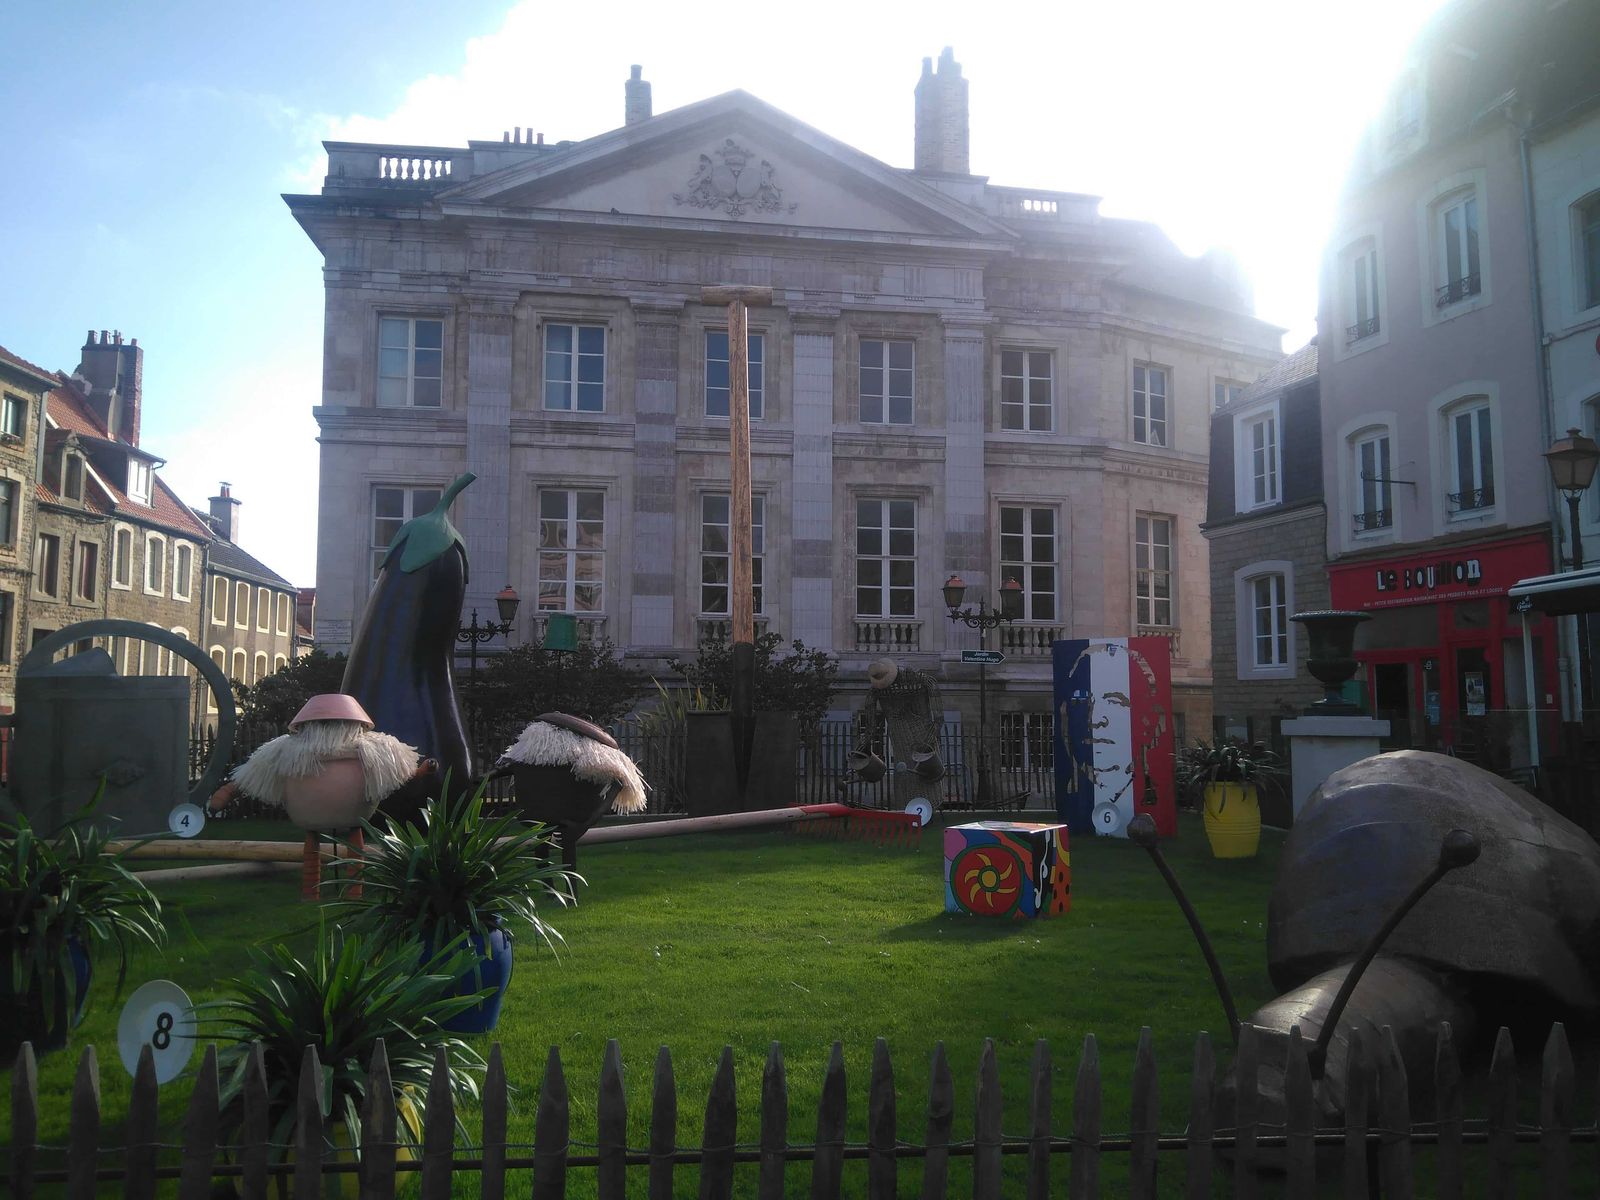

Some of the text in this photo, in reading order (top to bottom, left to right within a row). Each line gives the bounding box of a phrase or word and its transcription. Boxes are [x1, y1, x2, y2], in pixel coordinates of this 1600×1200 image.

[1376, 570, 1397, 591] Le
[180, 814, 190, 828] 4
[1104, 811, 1112, 823] 6
[152, 1012, 174, 1050] 8
